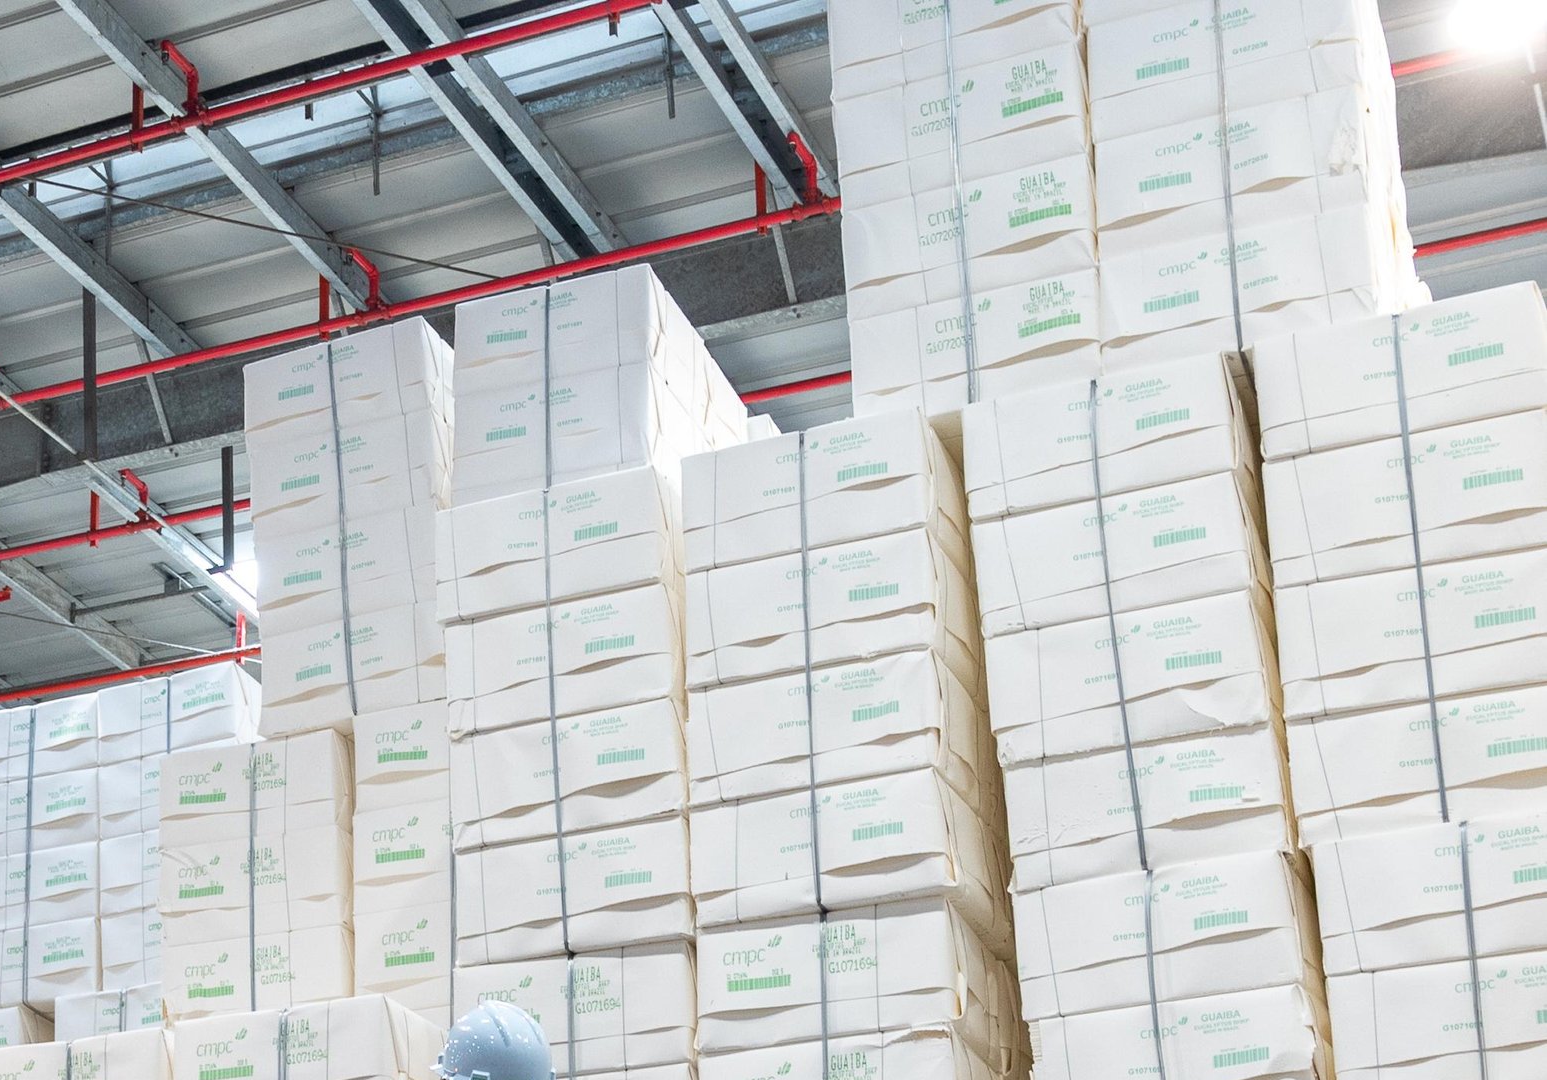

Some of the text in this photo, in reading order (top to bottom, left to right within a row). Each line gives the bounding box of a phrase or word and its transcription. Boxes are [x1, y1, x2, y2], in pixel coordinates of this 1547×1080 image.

[1153, 27, 1188, 43] cmpc
[1011, 59, 1047, 80] GUAIBA
[1155, 140, 1191, 157] cmpc
[1020, 171, 1055, 191] GUAIBA
[1159, 260, 1196, 277] cmpc
[1030, 281, 1064, 300] GUAIBA
[502, 305, 528, 317] cmpc
[1432, 311, 1471, 327] GUAIBA
[292, 359, 316, 373] cmpc
[1125, 378, 1163, 392] GUAIBA
[500, 401, 526, 412] cmpc
[830, 432, 864, 444] GUAIBA
[1450, 435, 1492, 449] GUAIBA
[294, 449, 319, 463] cmpc
[566, 490, 596, 503] GUAIBA
[1139, 495, 1176, 508] GUAIBA
[296, 544, 322, 558] cmpc
[838, 550, 873, 562] GUAIBA
[1462, 570, 1504, 584] GUAIBA
[581, 604, 613, 615] GUAIBA
[1153, 616, 1193, 629] GUAIBA
[308, 637, 333, 652] cmpc
[841, 668, 876, 680] GUAIBA
[1473, 700, 1516, 713] GUAIBA
[590, 717, 622, 727] GUAIBA
[375, 730, 408, 745] cmpc
[1177, 750, 1216, 761] GUAIBA
[179, 772, 210, 786] cmpc
[842, 788, 878, 799] GUAIBA
[373, 828, 404, 842] cmpc
[1498, 826, 1540, 839] GUAIBA
[597, 837, 630, 847] GUAIBA
[1435, 844, 1473, 857] cmpc
[178, 864, 207, 879] cmpc
[1182, 875, 1220, 889] GUAIBA
[382, 929, 414, 945] cmpc
[256, 946, 282, 959] GUAIBA
[723, 949, 766, 967] cmpc
[185, 963, 216, 978] cmpc
[829, 960, 877, 974] G1071694
[575, 999, 620, 1014] G1071694
[1201, 1010, 1241, 1022] GUAIBA
[196, 1040, 233, 1058] cmpc
[286, 1051, 327, 1065] G1071694
[831, 1052, 867, 1071] GUAIBA
